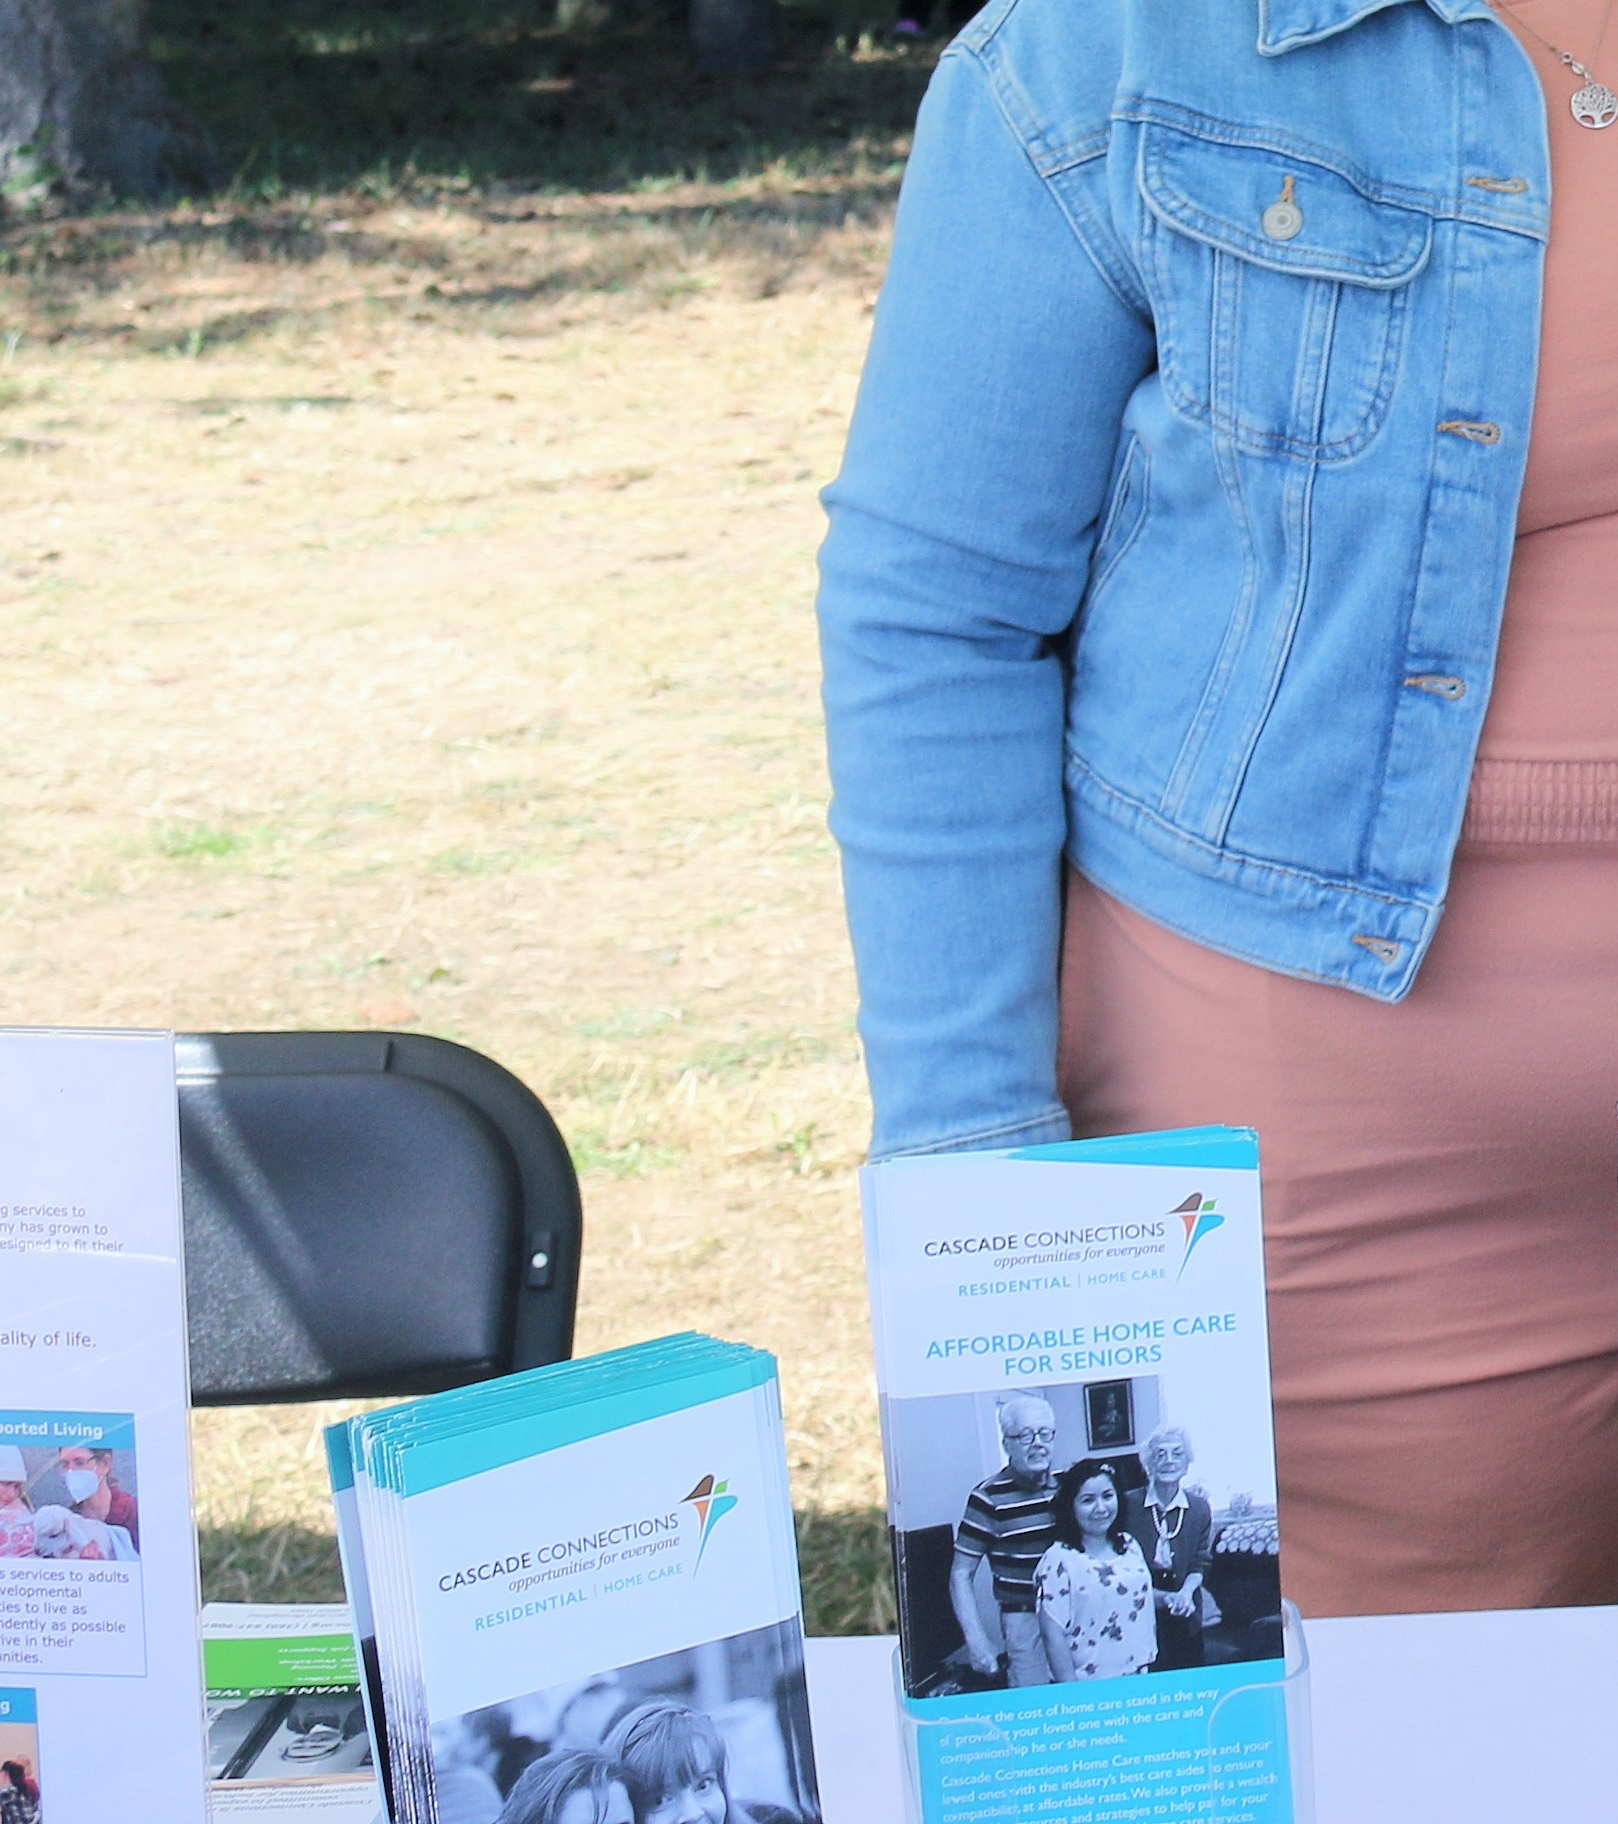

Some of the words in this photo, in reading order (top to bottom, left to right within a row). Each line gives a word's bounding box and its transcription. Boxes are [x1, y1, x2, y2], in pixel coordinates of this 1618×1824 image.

[20, 1221, 43, 1233] has
[48, 1223, 89, 1235] grown
[93, 1223, 107, 1235] to
[924, 1234, 1017, 1256] CASCADE
[1024, 1222, 1164, 1247] CONNECTIONS
[0, 1238, 51, 1252] esigned
[55, 1238, 69, 1248] to
[73, 1239, 87, 1250] fit
[91, 1239, 124, 1251] their
[993, 1248, 1080, 1269] opportunities
[1080, 1245, 1103, 1262] for
[1106, 1244, 1165, 1257] everyone
[958, 1275, 1071, 1296] RESIDENTIAL
[1087, 1271, 1126, 1284] HOME
[1131, 1267, 1165, 1280] CARE
[0, 1330, 36, 1348] ality
[43, 1331, 59, 1346] of
[66, 1331, 96, 1347] life.
[925, 1327, 1085, 1359] AFFORDABLE
[1093, 1319, 1164, 1343] HOME
[1172, 1313, 1236, 1335] CARE
[1004, 1354, 1053, 1376] FOR
[1060, 1344, 1161, 1370] SENIORS
[438, 1551, 531, 1591] CASCADE
[537, 1512, 678, 1563] CONNECTIONS
[508, 1559, 596, 1592] opportunities
[597, 1553, 618, 1571] for
[620, 1536, 679, 1560] everyone
[10, 1569, 65, 1581] services
[69, 1570, 83, 1581] to
[88, 1571, 128, 1582] adults
[475, 1590, 587, 1630] RESIDENTIAL
[603, 1572, 642, 1593] HOME
[647, 1562, 682, 1581] CARE
[51, 1621, 66, 1631] as
[71, 1621, 125, 1633] possible
[249, 1688, 281, 1698] TO
[284, 1685, 349, 1695] WANT
